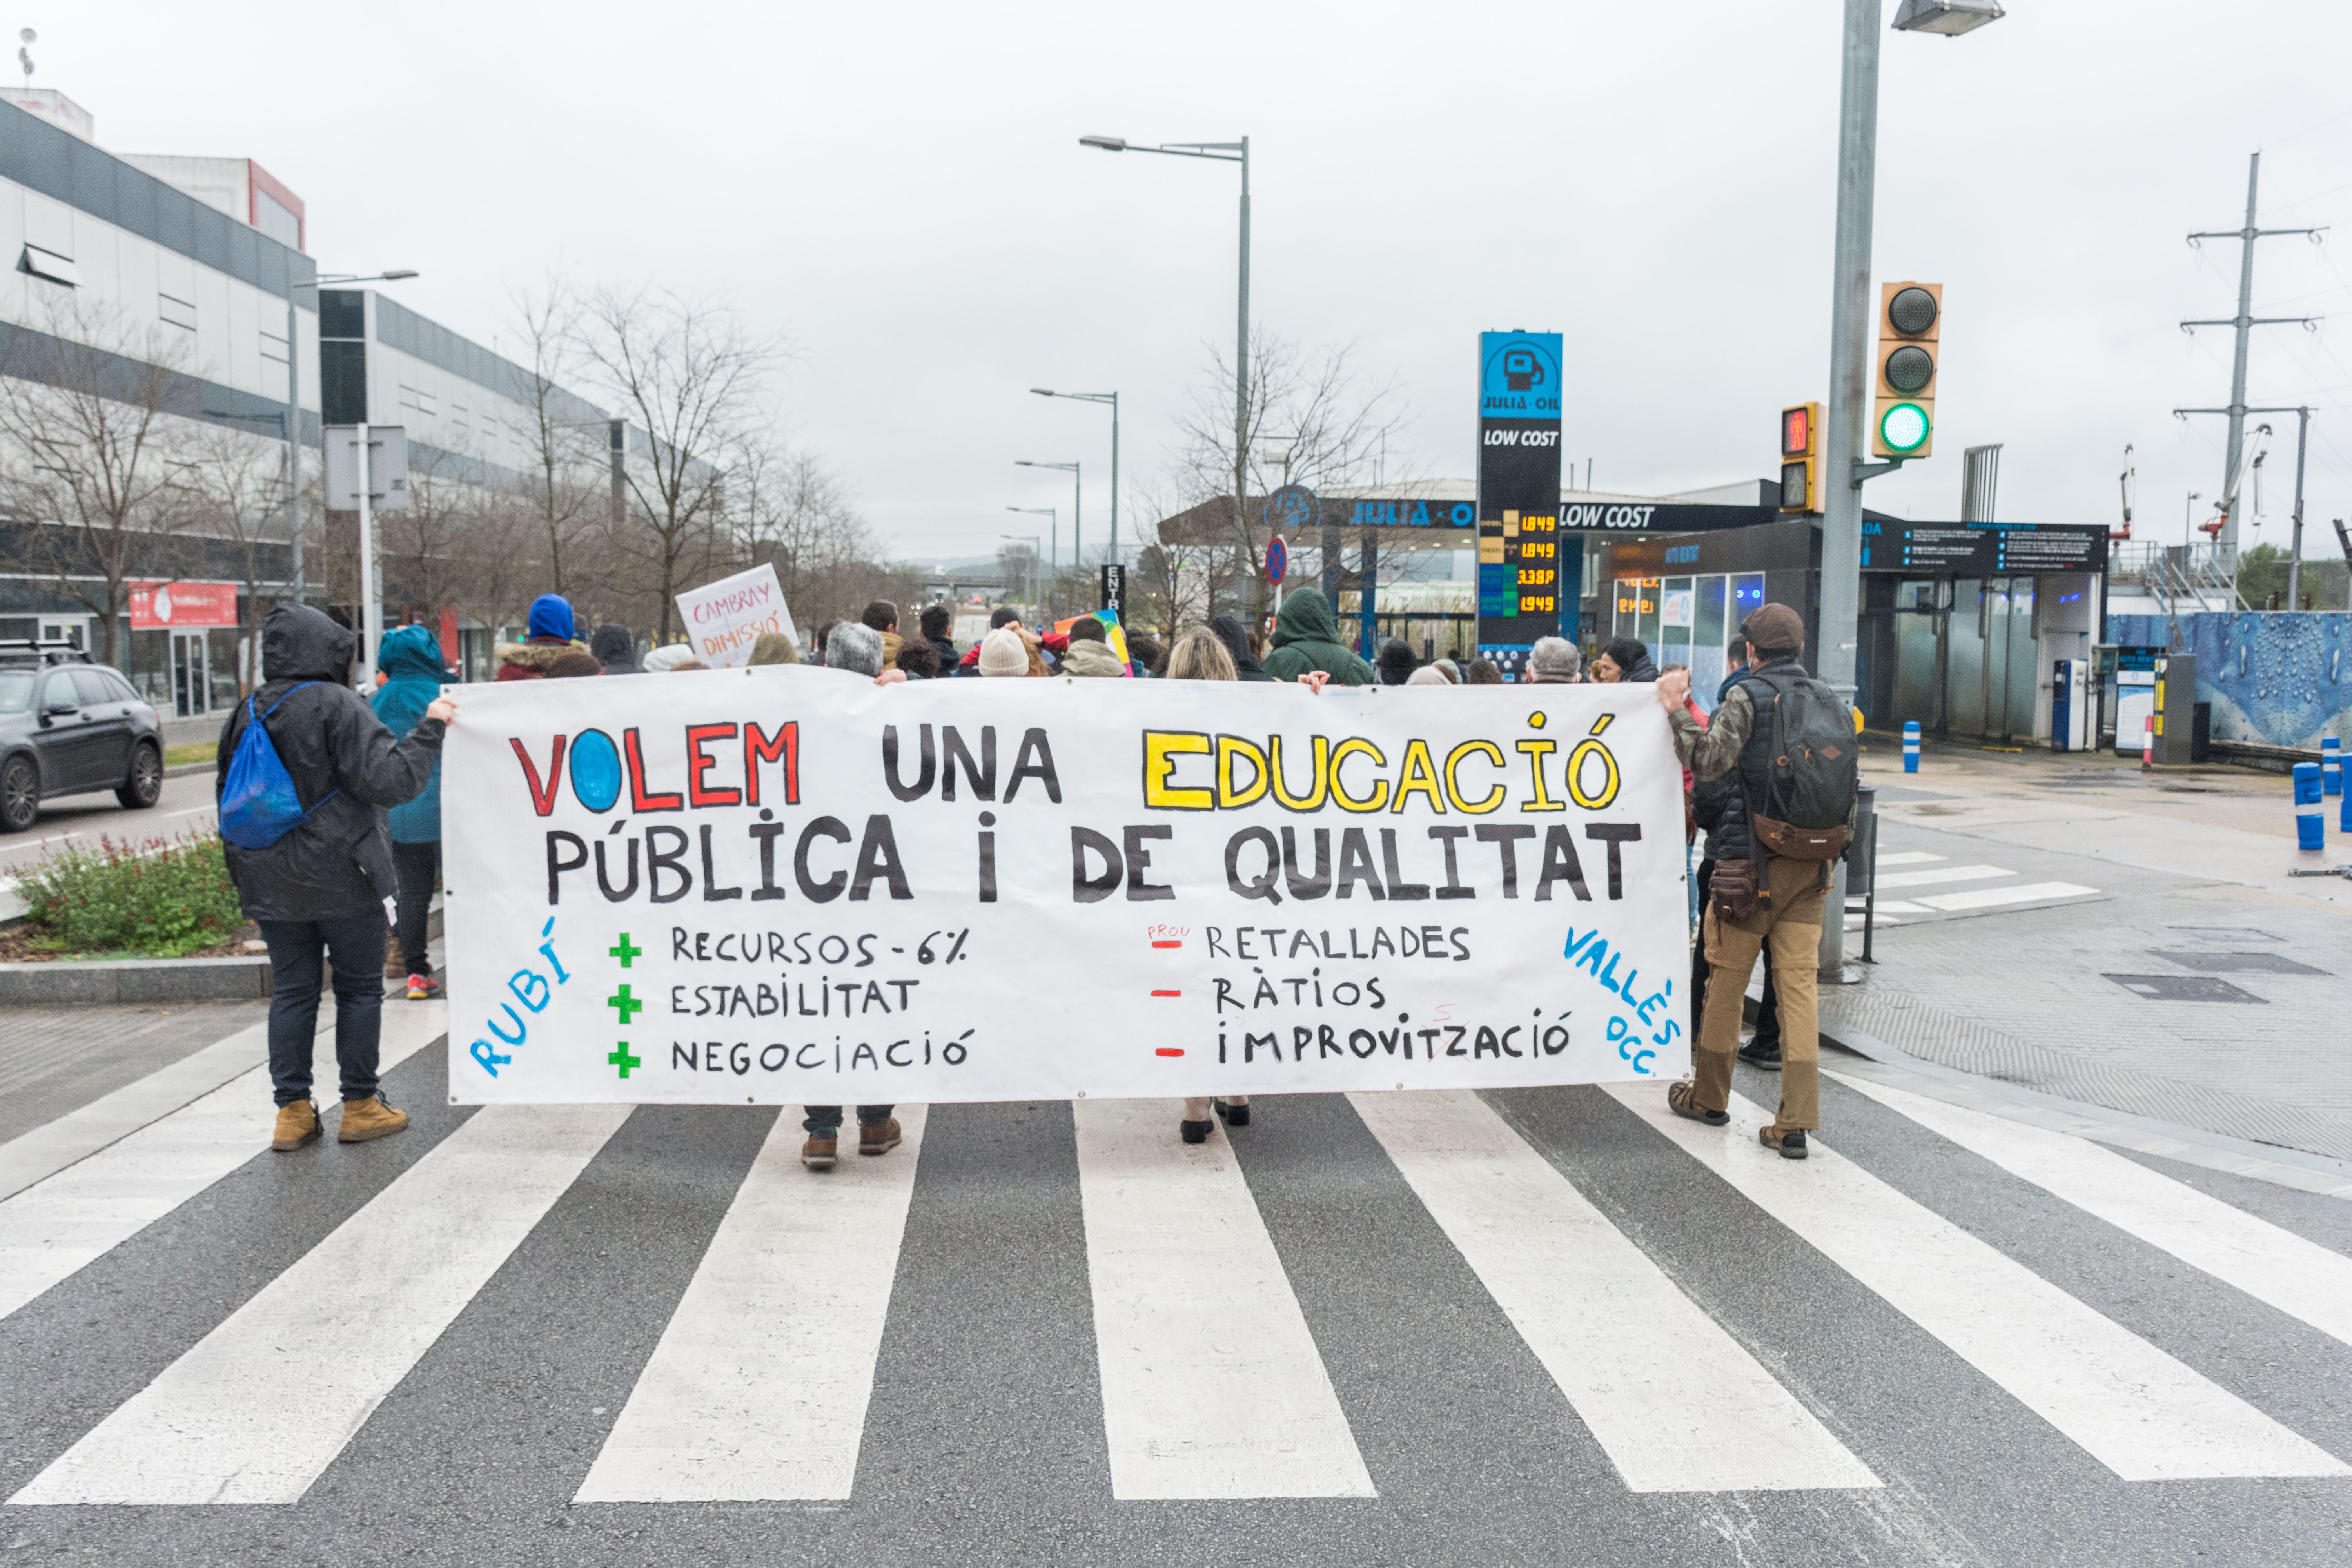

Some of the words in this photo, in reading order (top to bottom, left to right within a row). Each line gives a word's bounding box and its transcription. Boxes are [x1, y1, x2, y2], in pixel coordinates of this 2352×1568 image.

[1536, 397, 1559, 410] OIL
[1484, 430, 1519, 446] LOW
[1521, 430, 1559, 446] COST
[1451, 503, 1476, 526] O
[1559, 505, 1604, 526] LOW
[1605, 506, 1655, 528] COST
[694, 581, 769, 624] CAMBRAY
[1108, 566, 1120, 610] ENTR
[702, 610, 779, 658] DIMISSIÓ
[509, 721, 801, 816] VOLEM
[882, 724, 1062, 803] UNA
[1142, 711, 1621, 815] EDUCACIÓ
[546, 808, 914, 905] PÚBLICA
[1071, 825, 1176, 902] DE
[1224, 823, 1642, 905] QUALITAT
[1148, 924, 1190, 940] PROU
[1206, 926, 1471, 961] RETALLADES
[470, 916, 570, 1078] RUBÍ
